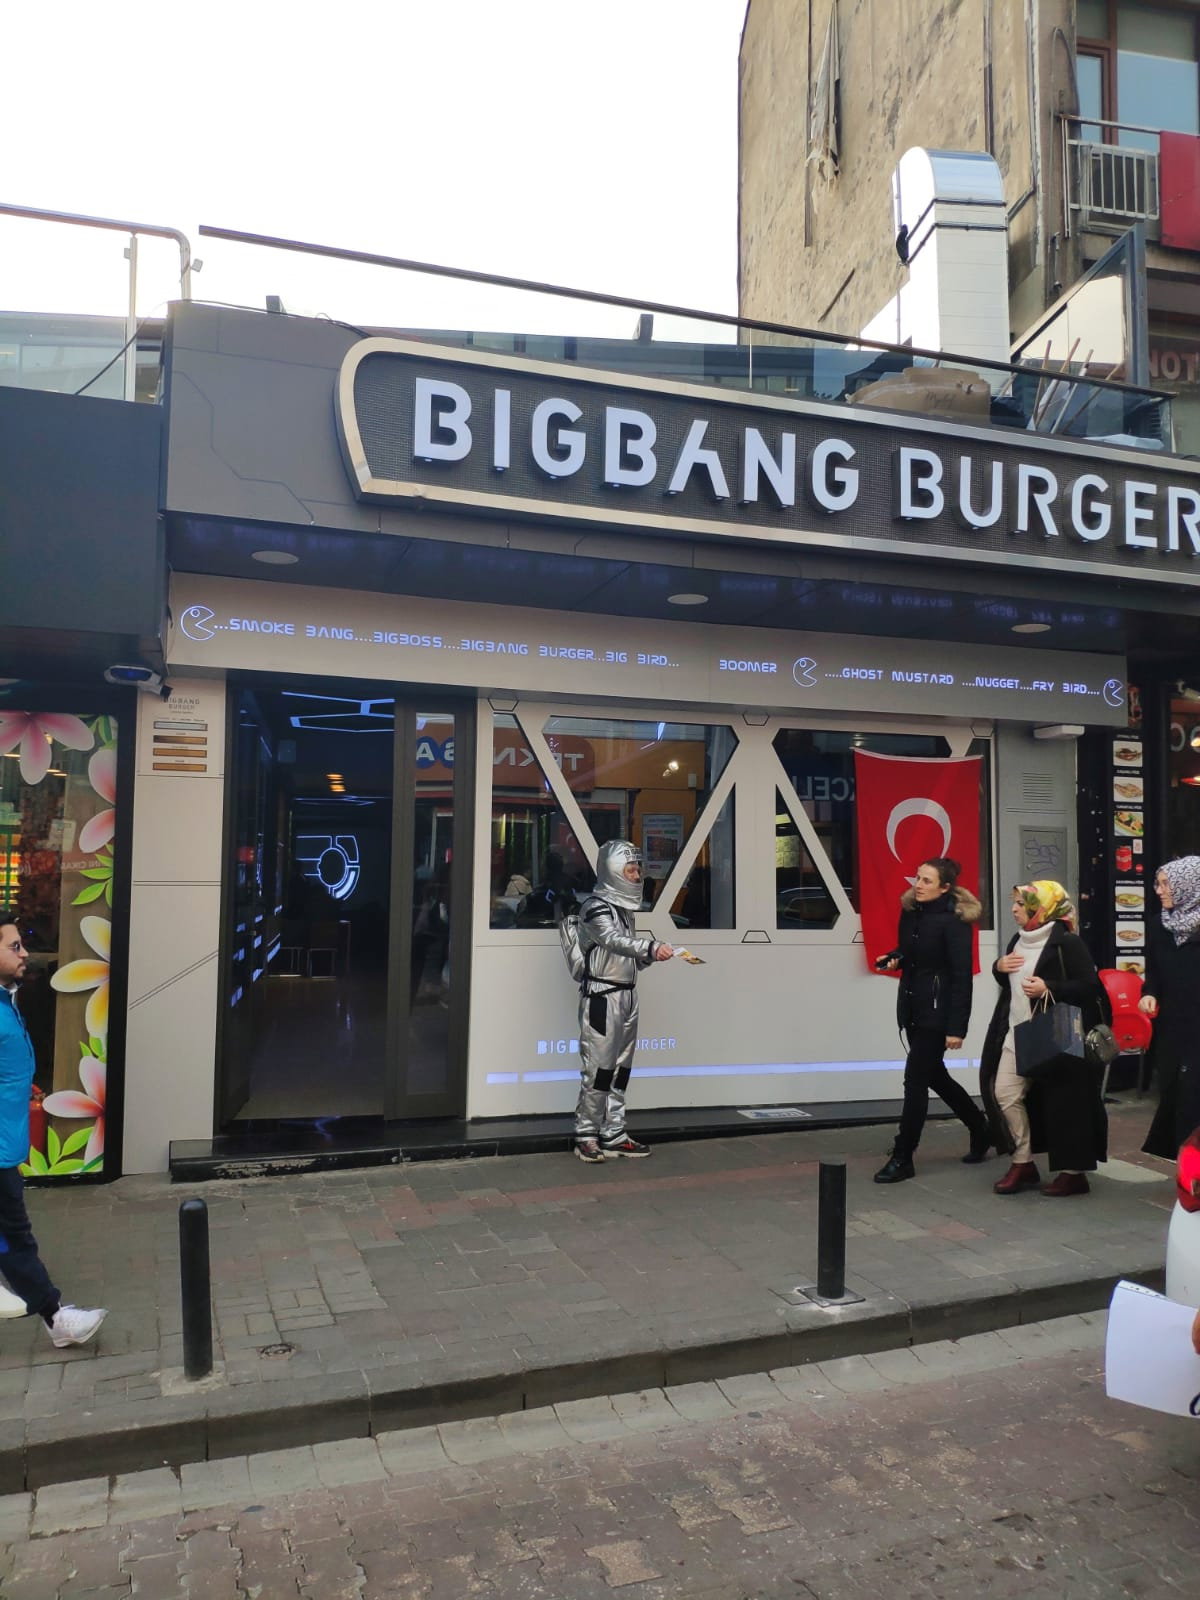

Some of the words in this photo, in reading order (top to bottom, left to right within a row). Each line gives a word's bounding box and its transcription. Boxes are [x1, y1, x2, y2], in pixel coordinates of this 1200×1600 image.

[413, 377, 859, 512] BIGBANG
[900, 447, 1200, 554] BURGER
[719, 659, 777, 673] BOOMER
[891, 671, 954, 685] MUSTARD
